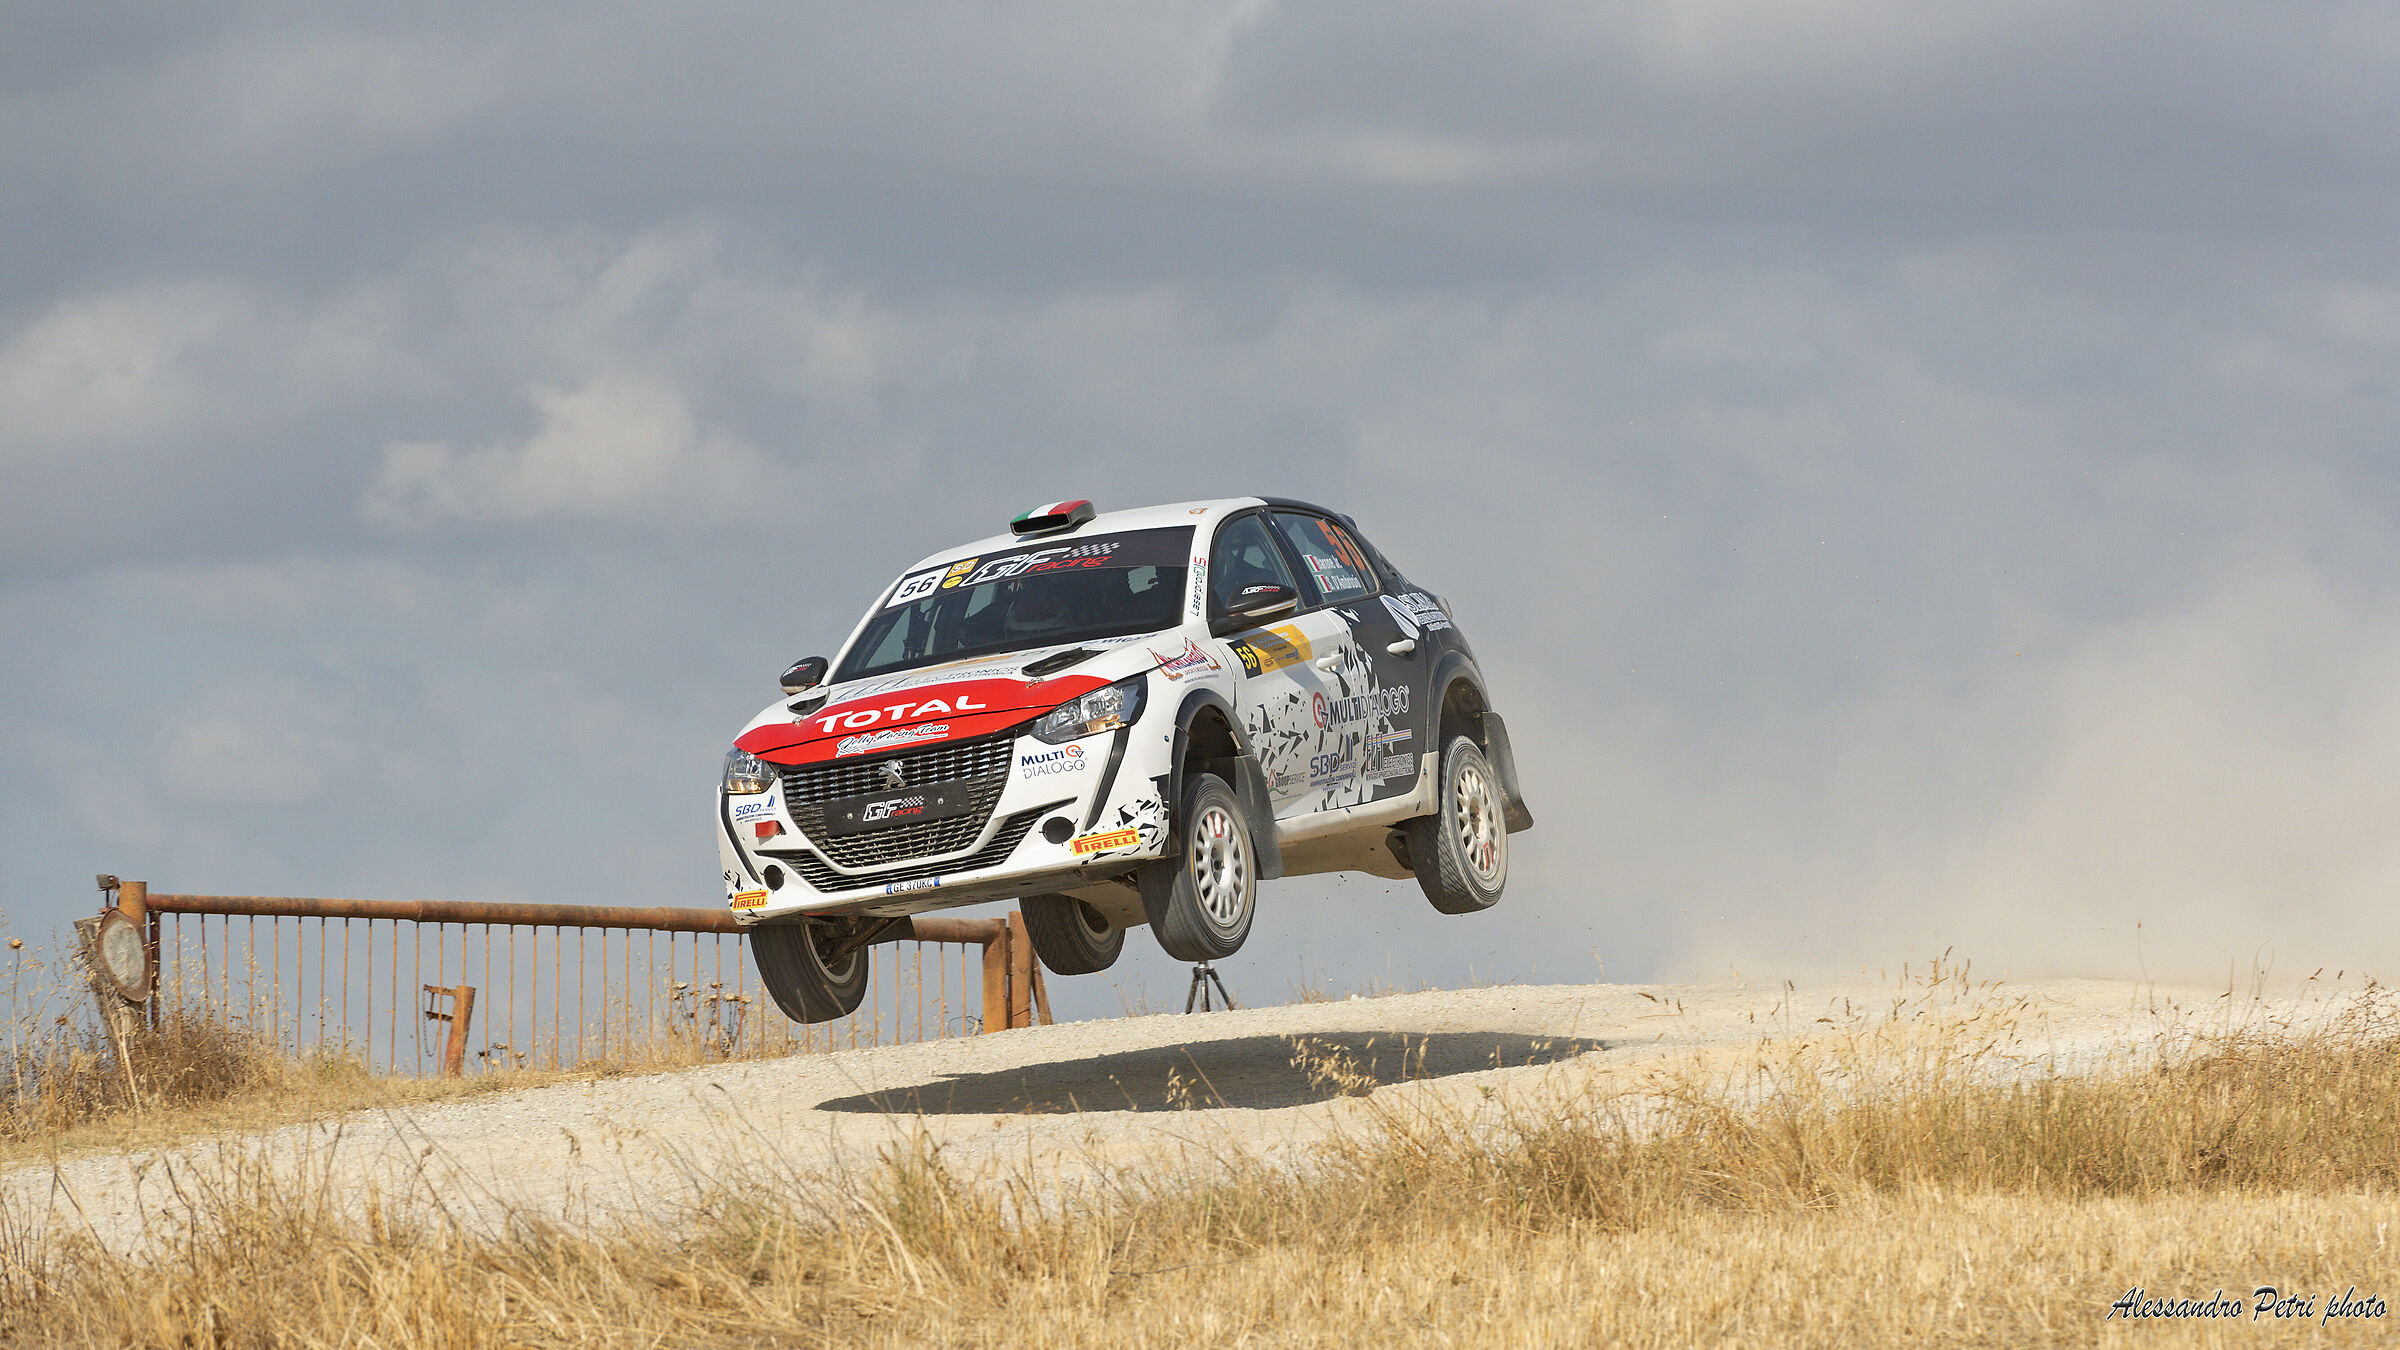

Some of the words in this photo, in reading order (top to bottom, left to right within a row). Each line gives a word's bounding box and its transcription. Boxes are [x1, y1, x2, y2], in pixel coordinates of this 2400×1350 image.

[1314, 519, 1366, 572] 56
[1026, 555, 1113, 574] racing
[900, 576, 937, 599] 56
[1235, 645, 1258, 671] 56
[815, 695, 987, 734] TOTAL
[1328, 685, 1409, 726] MULTIDIALOGO
[917, 723, 950, 734] Team
[1021, 750, 1065, 767] MULTI
[1023, 759, 1085, 779] DIALOGO
[1309, 752, 1340, 778] SBD
[735, 803, 762, 817] SBD
[862, 798, 903, 822] GF
[890, 806, 924, 817] racing
[1073, 829, 1138, 854] PIRELLI
[734, 891, 768, 909] PIRELLI
